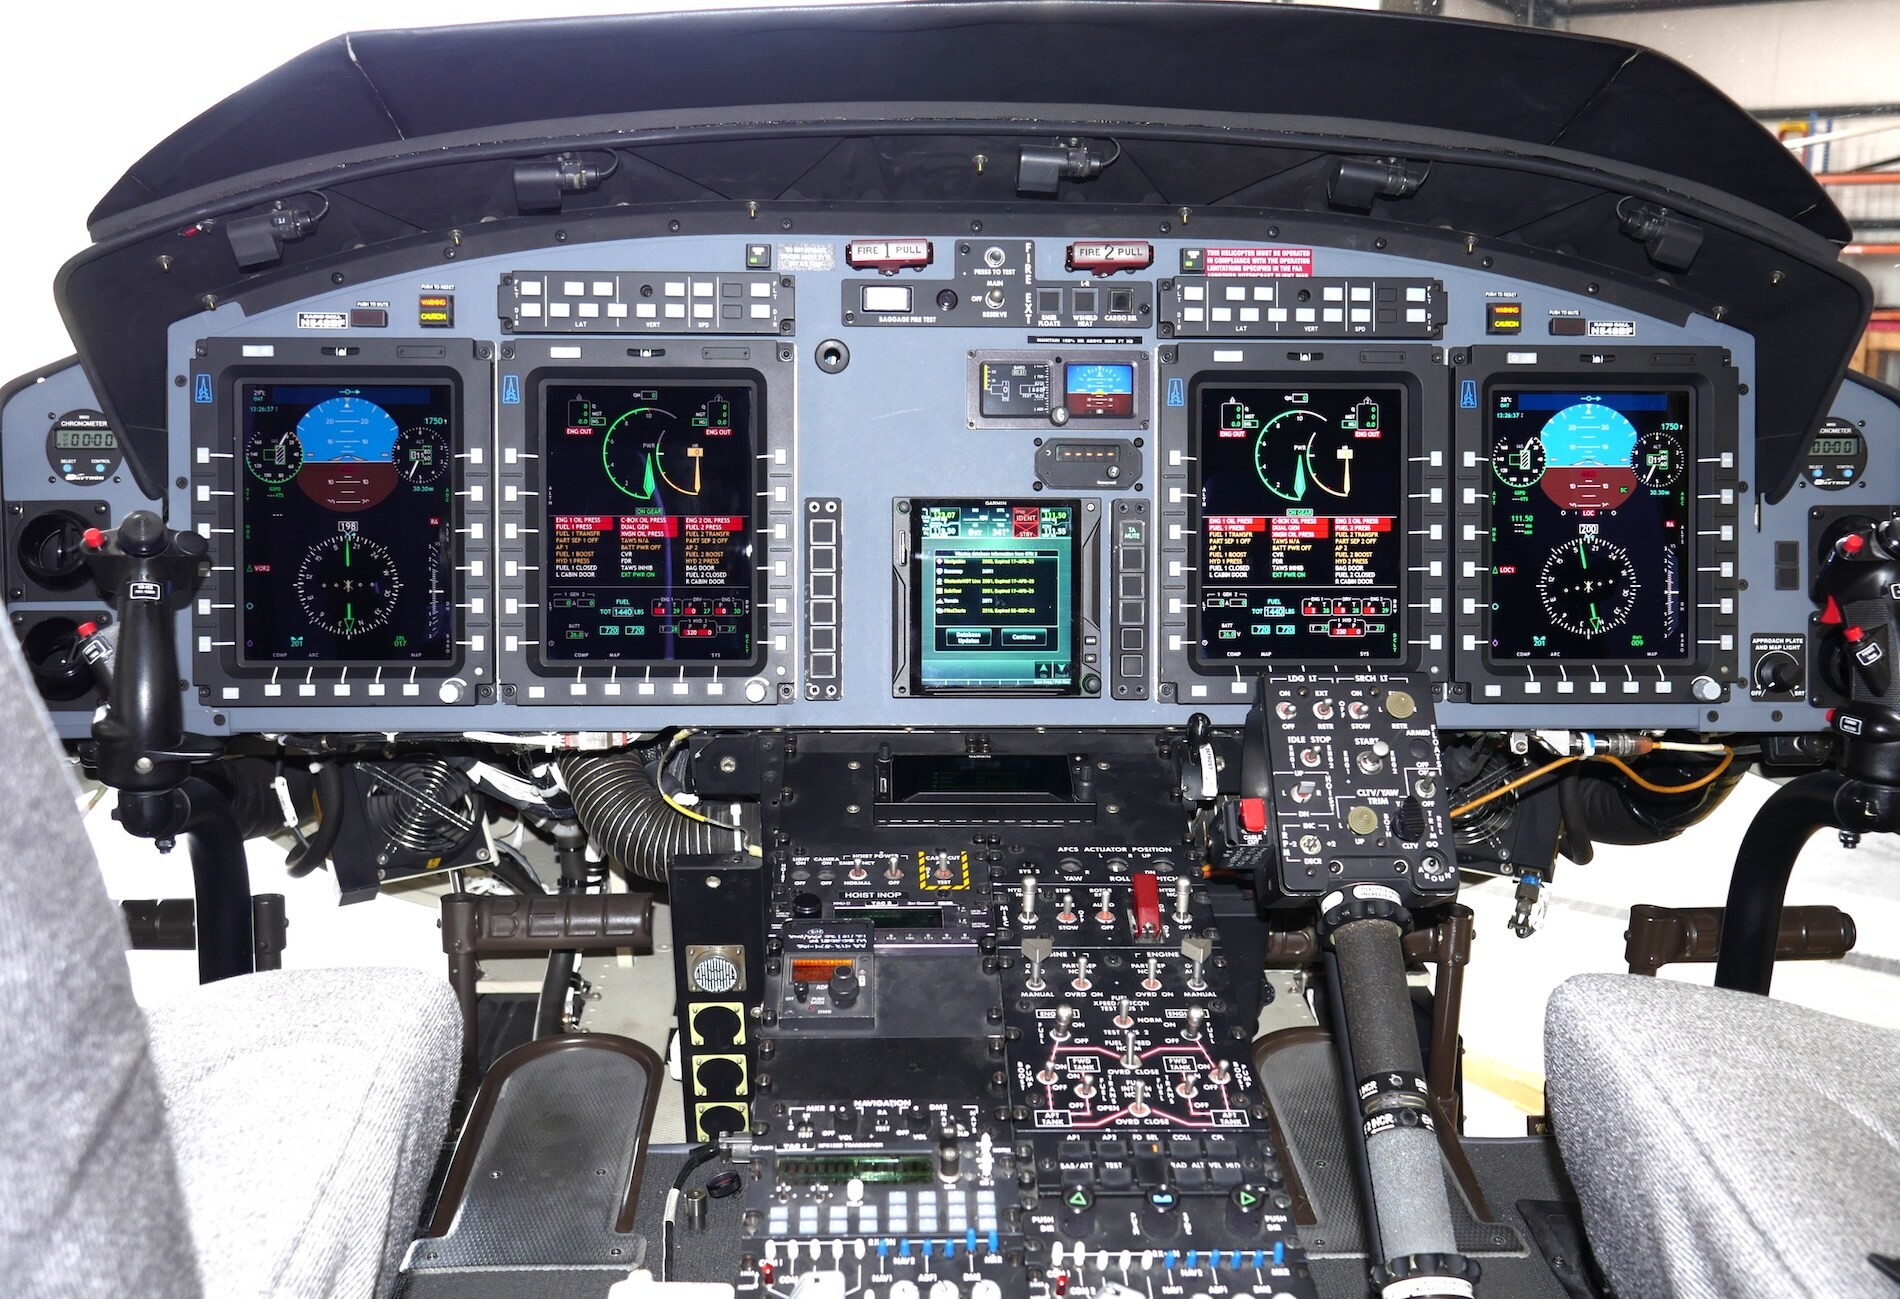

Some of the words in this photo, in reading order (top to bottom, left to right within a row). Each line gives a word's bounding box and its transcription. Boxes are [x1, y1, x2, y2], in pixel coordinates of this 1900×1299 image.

[858, 247, 878, 255] FIRE
[884, 243, 889, 259] 1
[896, 246, 922, 254] PULL
[1080, 248, 1100, 257] FIRE
[1104, 245, 1114, 260] 2
[1118, 248, 1143, 257] PULL
[1024, 242, 1032, 285] FIRE
[1024, 293, 1032, 324] EXT
[490, 897, 634, 938] BELL
[1371, 1112, 1394, 1127] INCR
